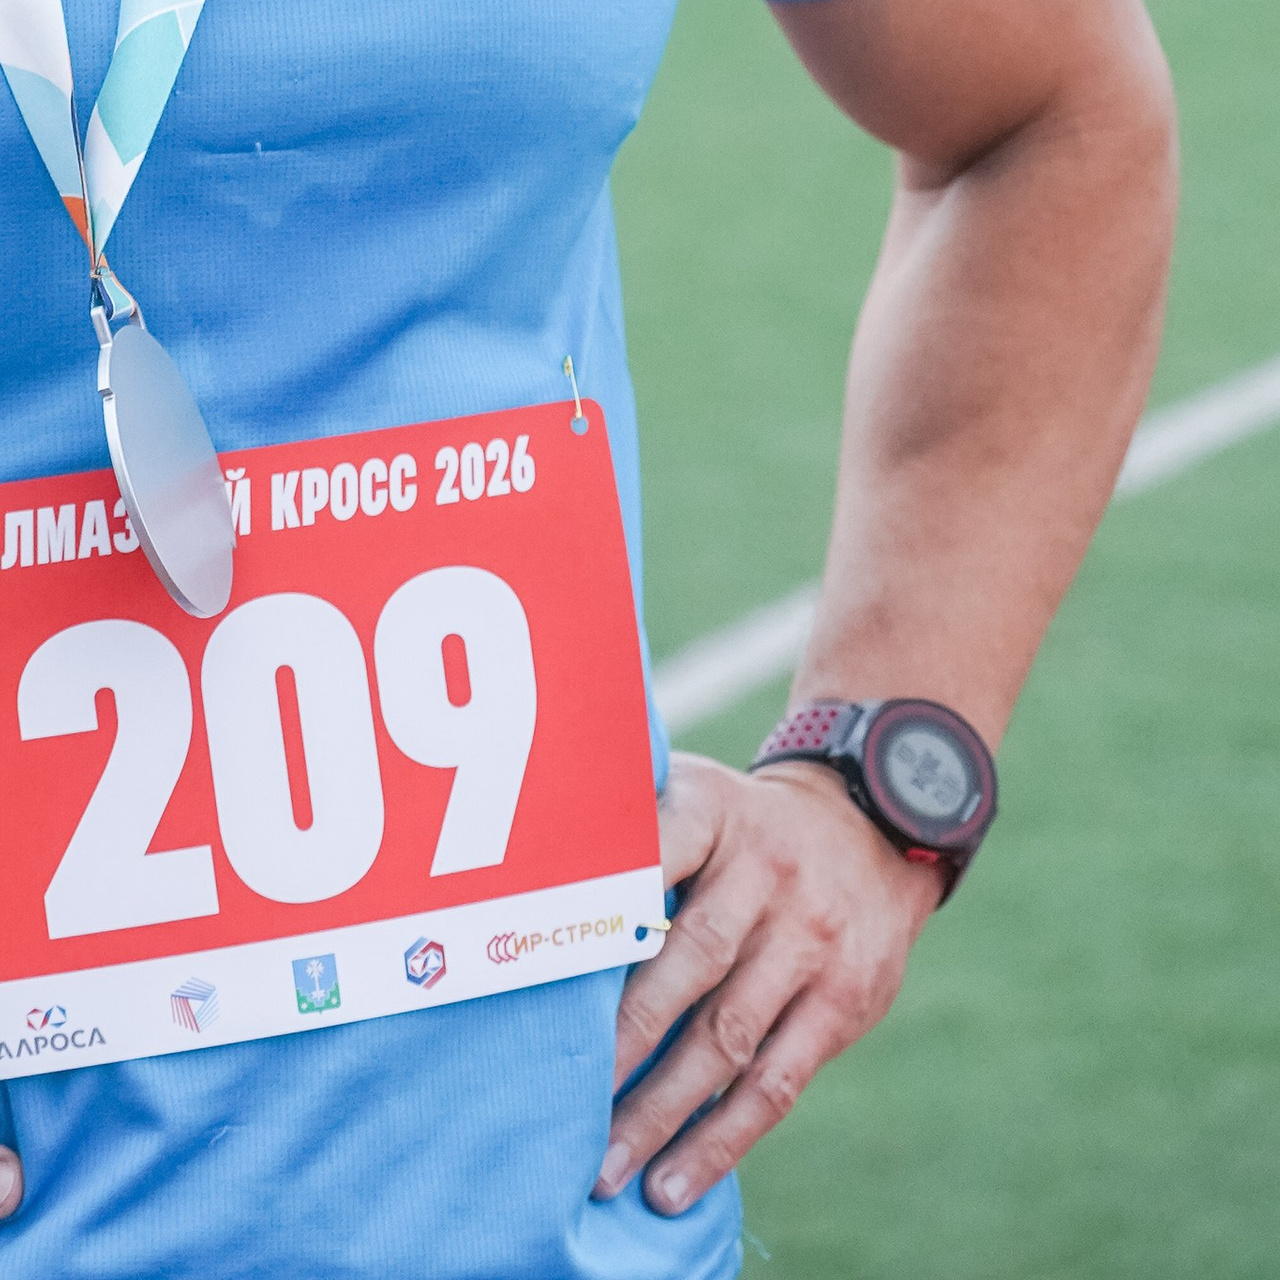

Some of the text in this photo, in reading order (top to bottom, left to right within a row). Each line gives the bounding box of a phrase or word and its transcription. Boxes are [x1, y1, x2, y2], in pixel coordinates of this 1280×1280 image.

[271, 453, 418, 532] КРОСС
[434, 434, 537, 506] 2026
[17, 565, 538, 940] 209
